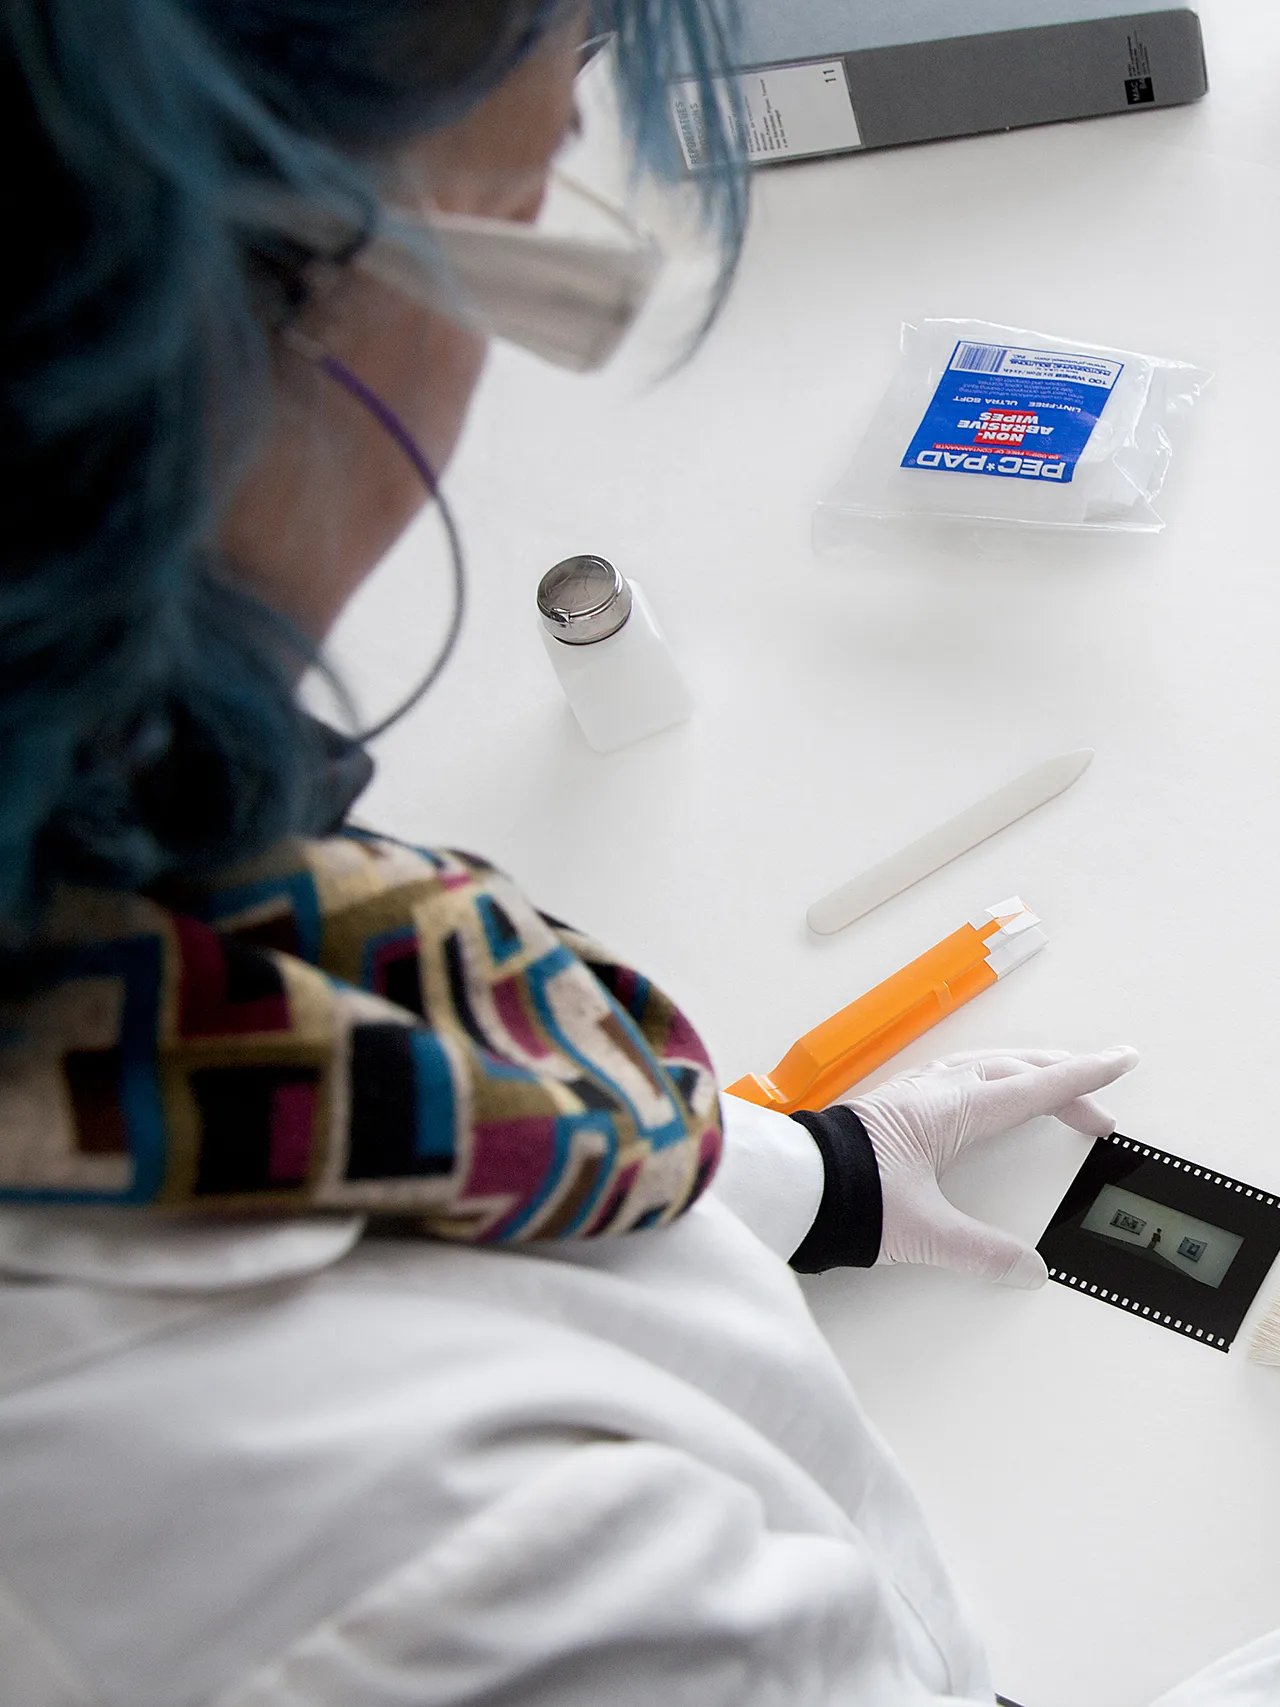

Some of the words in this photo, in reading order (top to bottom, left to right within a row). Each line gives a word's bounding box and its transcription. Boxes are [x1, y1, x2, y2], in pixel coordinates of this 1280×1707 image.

[821, 68, 837, 84] 11
[1054, 373, 1085, 381] WIPES
[1087, 377, 1107, 385] 100
[952, 395, 981, 403] SOFT
[984, 397, 1018, 406] ULTRA
[1027, 401, 1081, 413] LINT-FREE
[978, 411, 1038, 424] WIPES
[956, 419, 1054, 435] ABRASIVE
[977, 431, 1024, 442] NON-
